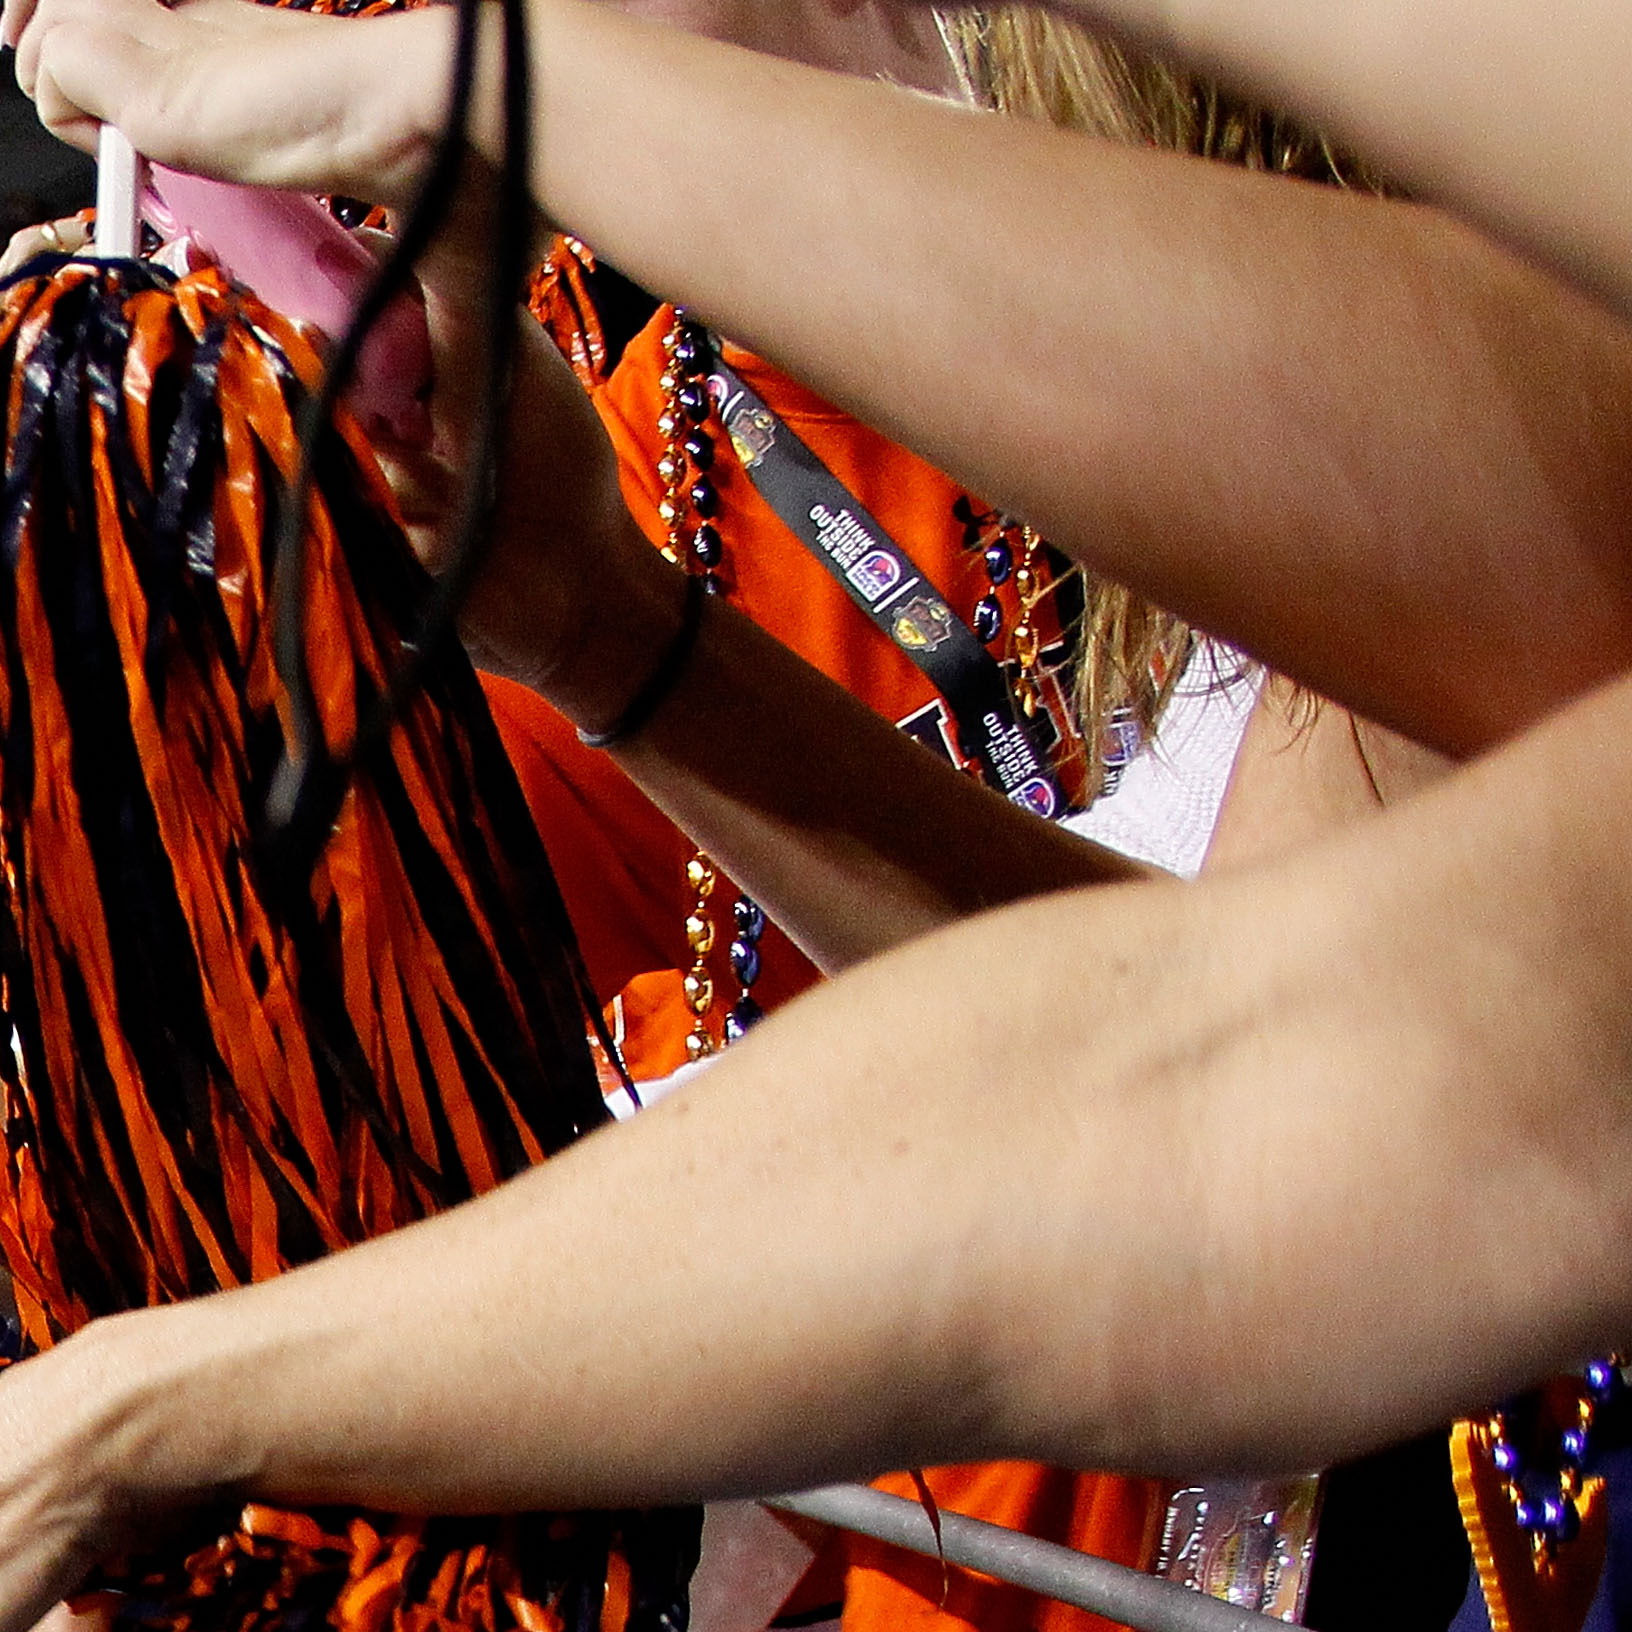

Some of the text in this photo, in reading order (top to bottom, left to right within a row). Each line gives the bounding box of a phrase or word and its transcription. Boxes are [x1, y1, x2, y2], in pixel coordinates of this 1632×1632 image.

[809, 504, 862, 560] OUTSIDE
[836, 509, 876, 551] THINK
[983, 713, 1026, 782] OUTSIDE
[1006, 724, 1038, 774] THINK
